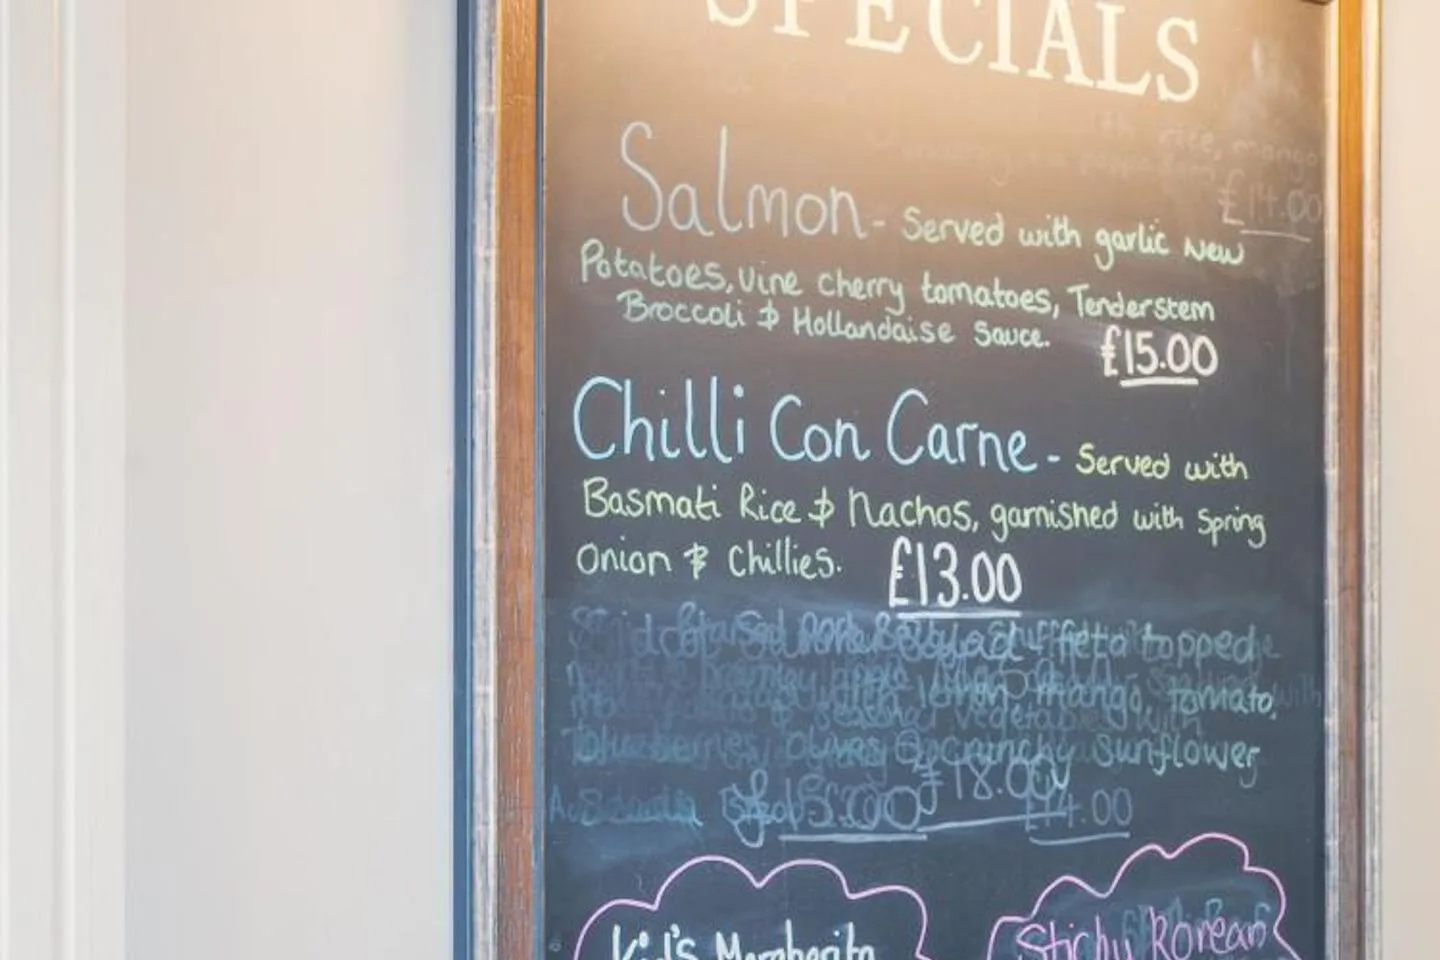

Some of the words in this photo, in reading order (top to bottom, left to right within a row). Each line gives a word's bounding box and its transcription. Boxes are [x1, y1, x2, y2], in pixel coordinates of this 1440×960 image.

[902, 205, 1005, 247] Served
[1018, 213, 1082, 249] with
[1094, 218, 1170, 271] garlic
[580, 238, 734, 295] Potatoes,
[817, 267, 906, 316] cherry
[921, 270, 1060, 320] tomatoes,
[1066, 283, 1216, 322] Tenderstem
[616, 288, 746, 329] Broccoli
[792, 306, 957, 345] Hollandaise
[1100, 323, 1219, 380] £15.00
[572, 374, 745, 465] Chilli
[769, 393, 872, 463] Con
[1074, 441, 1171, 481] Served
[1184, 451, 1250, 482] with
[582, 476, 722, 521] Basmati
[739, 482, 802, 525] Rice
[989, 498, 1119, 543] garnished
[1132, 503, 1185, 532] with
[576, 535, 673, 577] Onion
[727, 535, 844, 582] Chillies.
[888, 534, 1023, 609] £13.00
